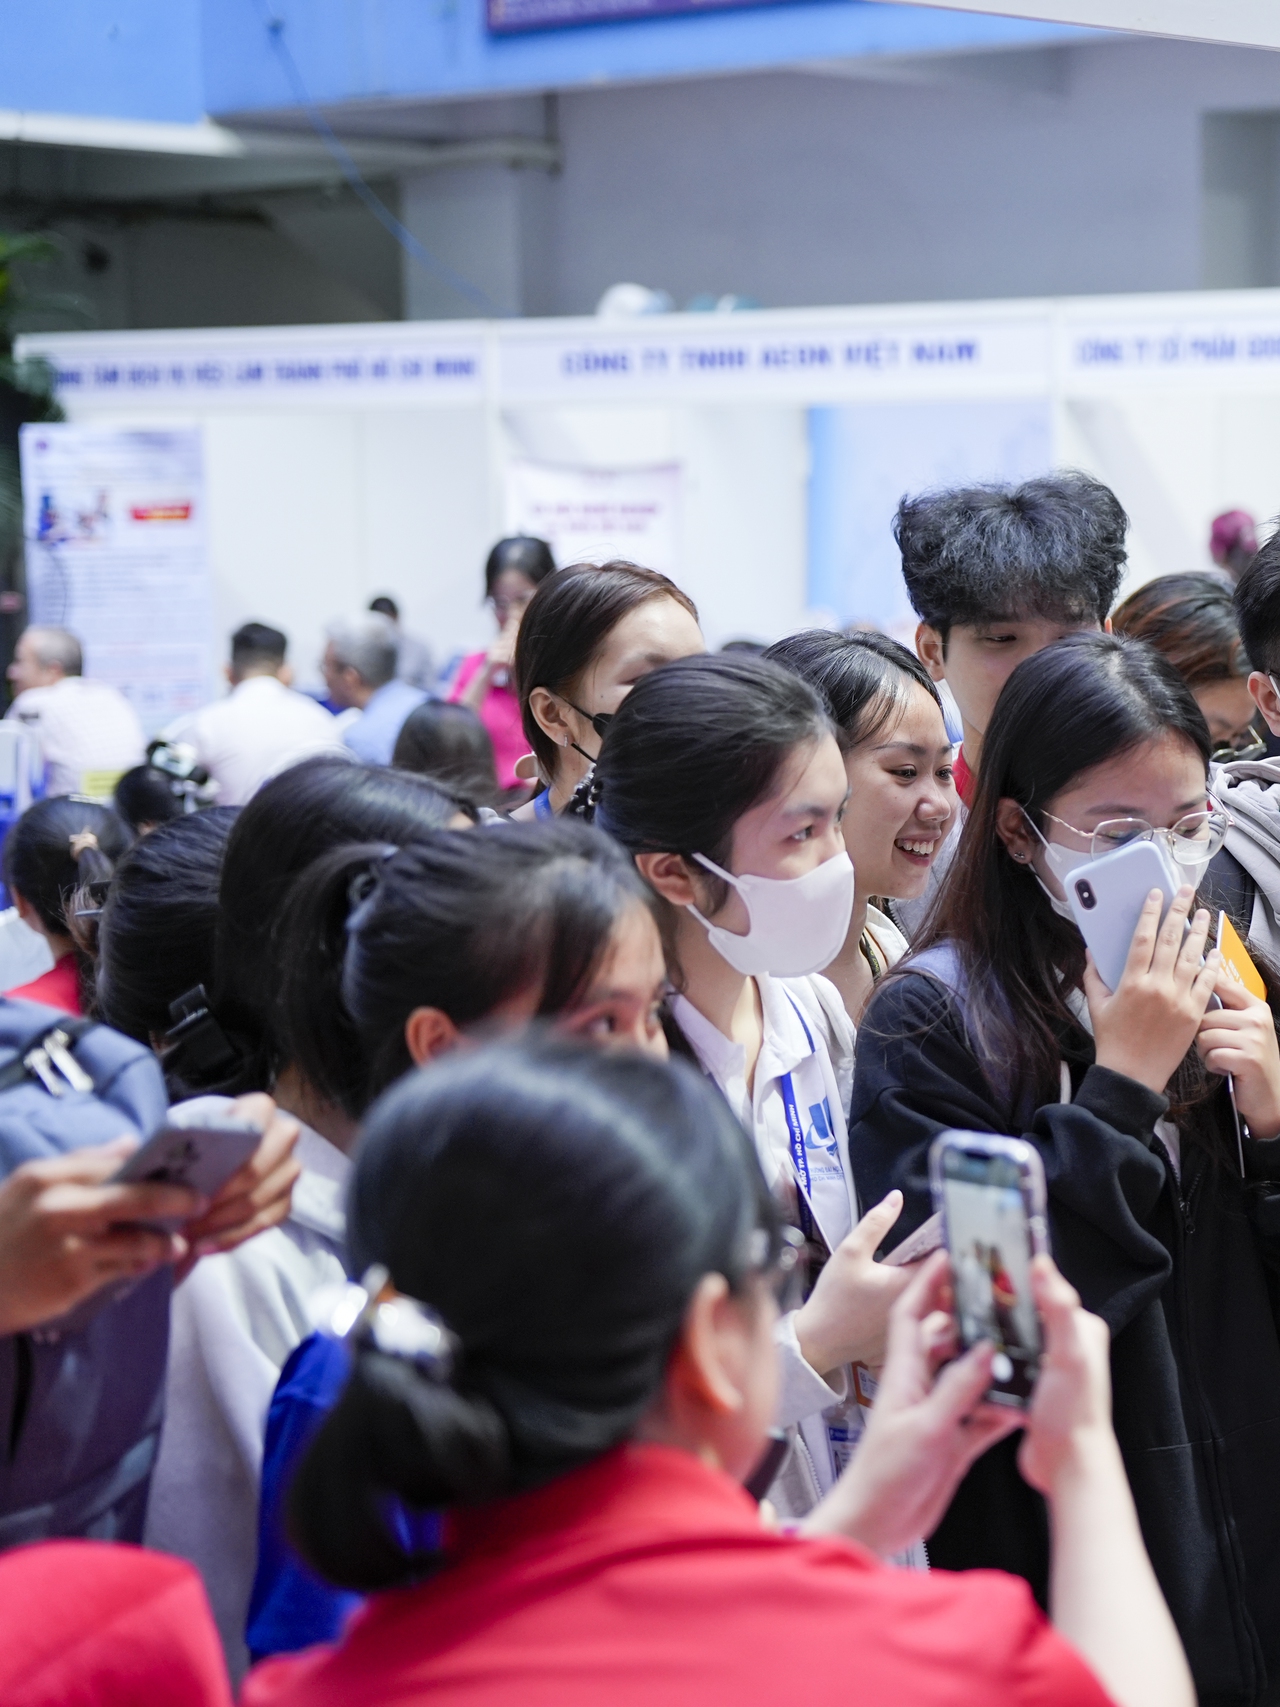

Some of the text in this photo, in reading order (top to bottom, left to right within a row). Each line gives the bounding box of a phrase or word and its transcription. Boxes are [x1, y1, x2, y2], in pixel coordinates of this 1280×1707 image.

[563, 344, 630, 373] CÔNG
[680, 347, 746, 370] TNHH
[913, 342, 976, 363] NAM
[789, 1104, 798, 1127] MINH
